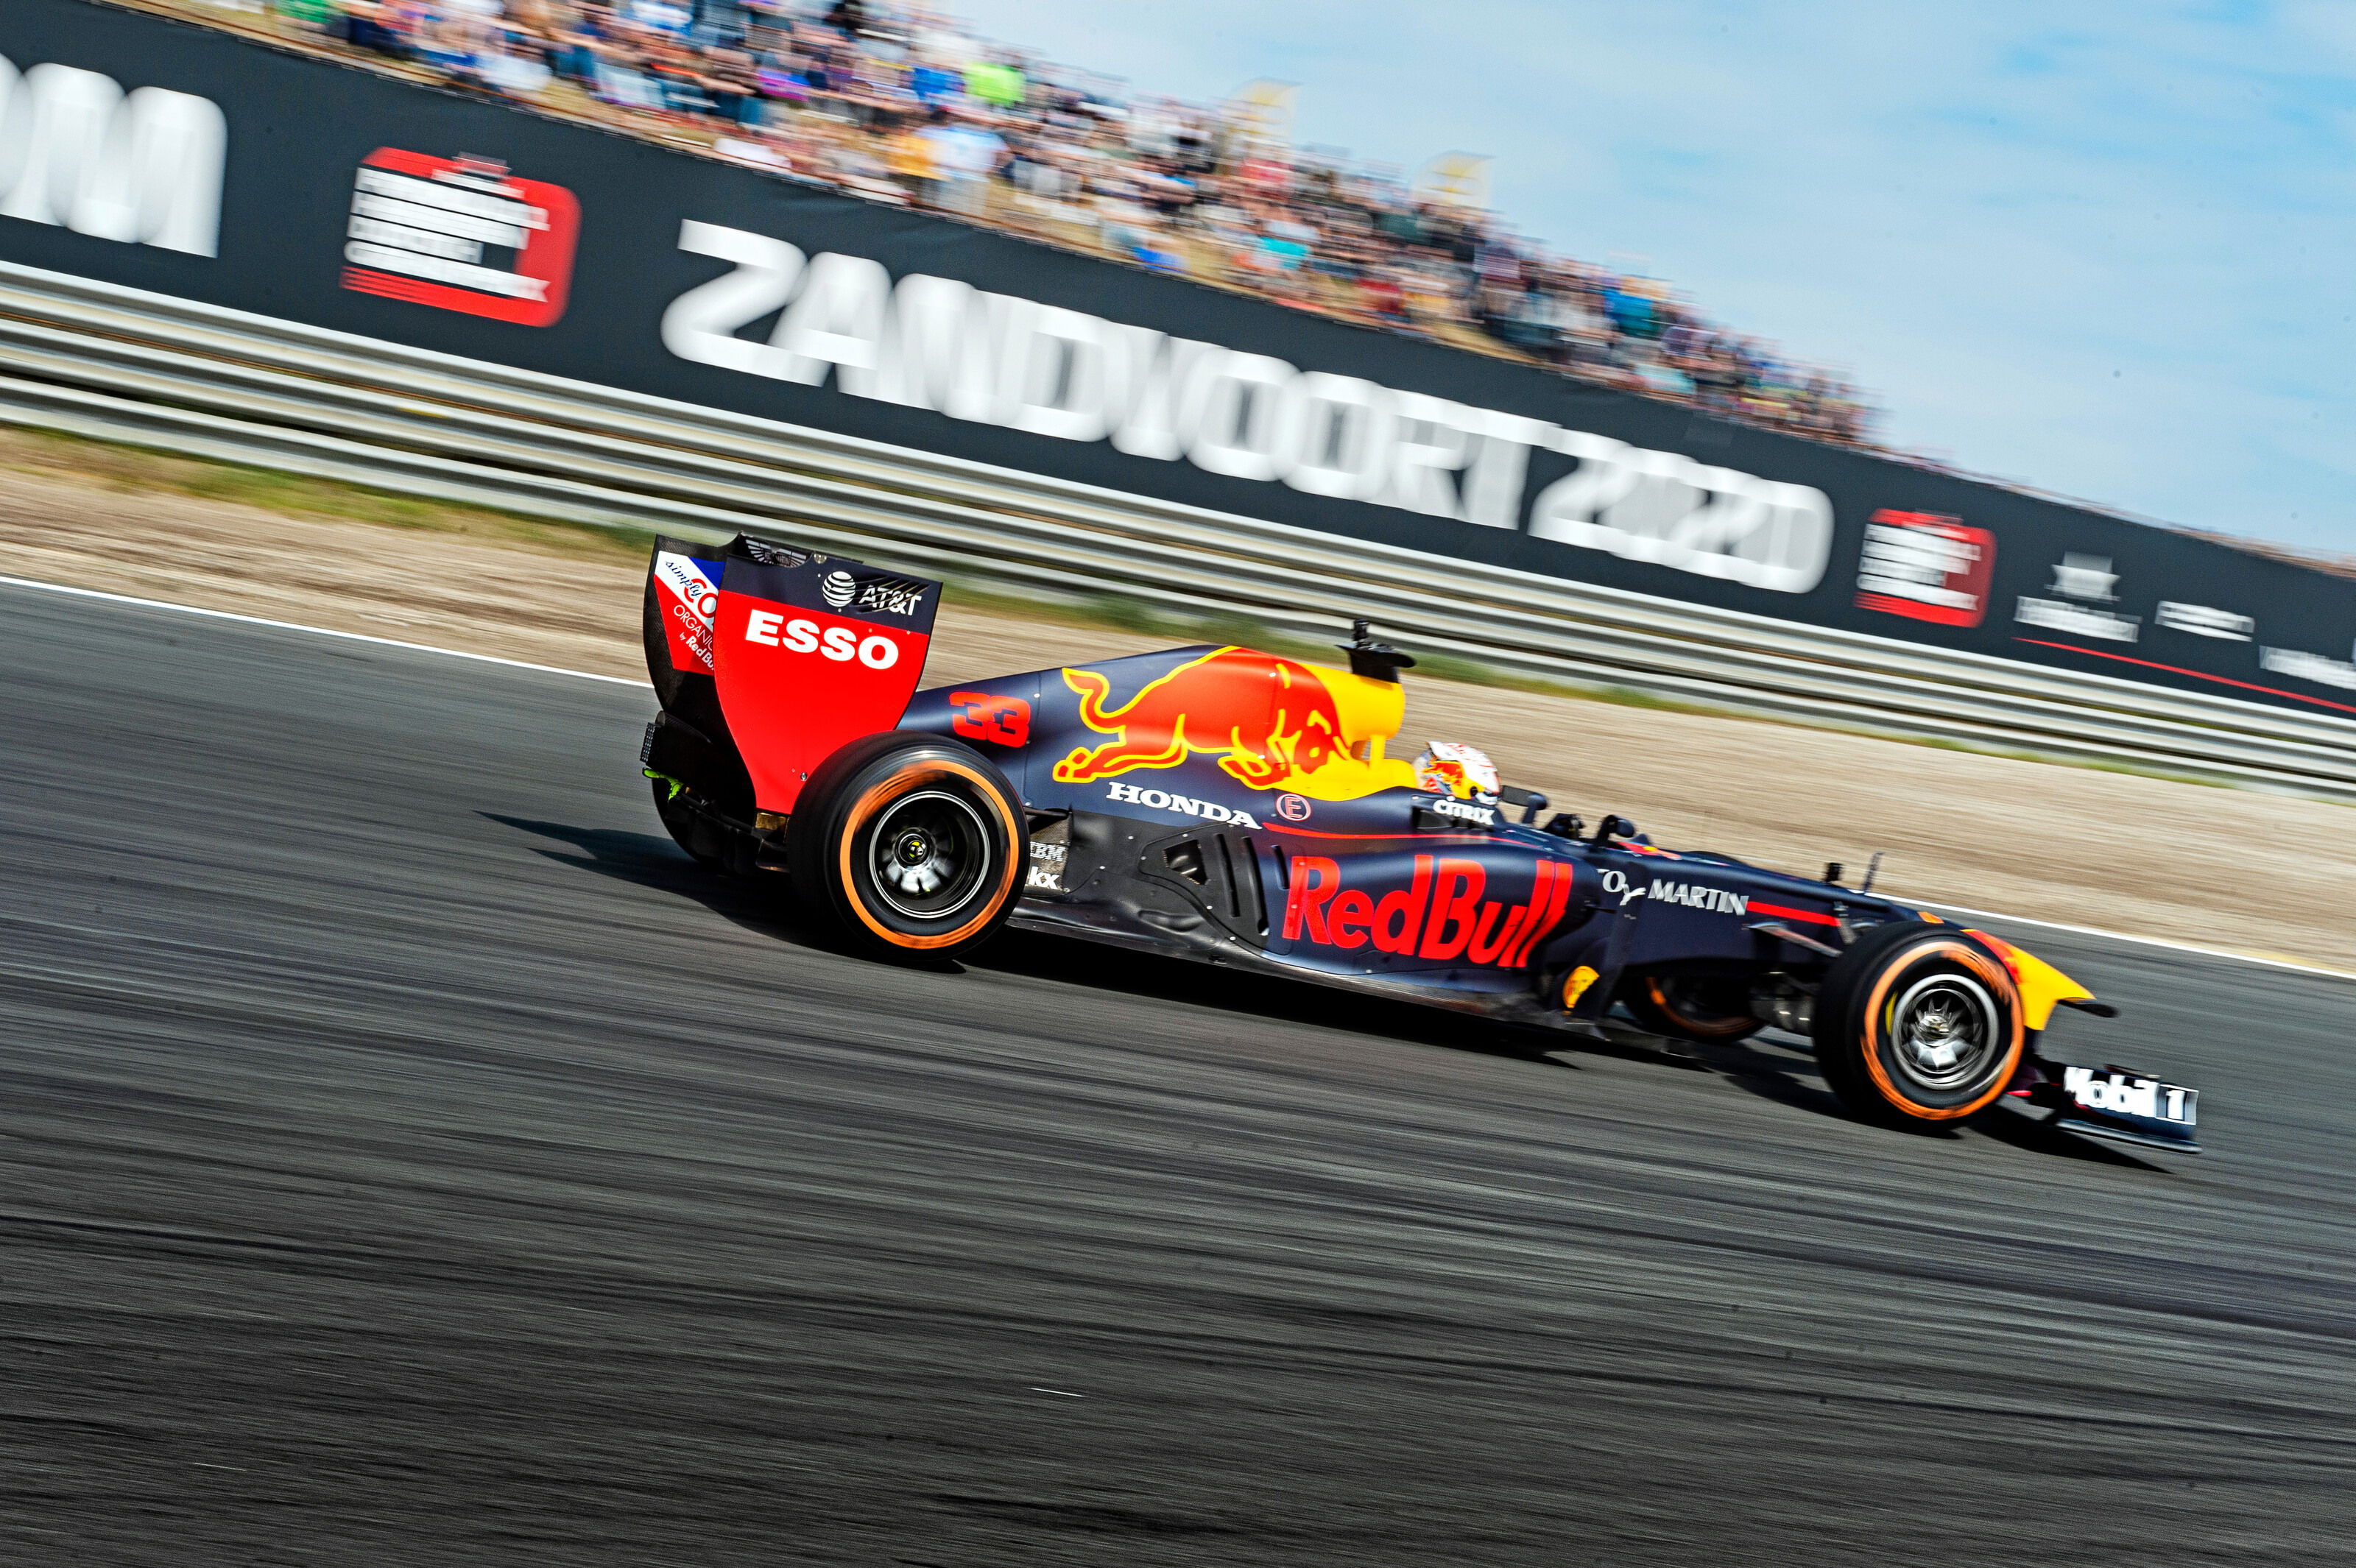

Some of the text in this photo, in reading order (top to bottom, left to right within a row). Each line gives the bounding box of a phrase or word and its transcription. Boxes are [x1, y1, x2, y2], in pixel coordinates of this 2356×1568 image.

[666, 560, 702, 598] simply
[858, 585, 922, 615] AT&T
[674, 604, 713, 651] ORGANIC
[745, 609, 899, 669] ESSO
[949, 691, 1031, 748] 33
[1106, 782, 1262, 830] HONDA
[1648, 878, 1749, 916] MARTIN
[2064, 1067, 2159, 1119] Mobil
